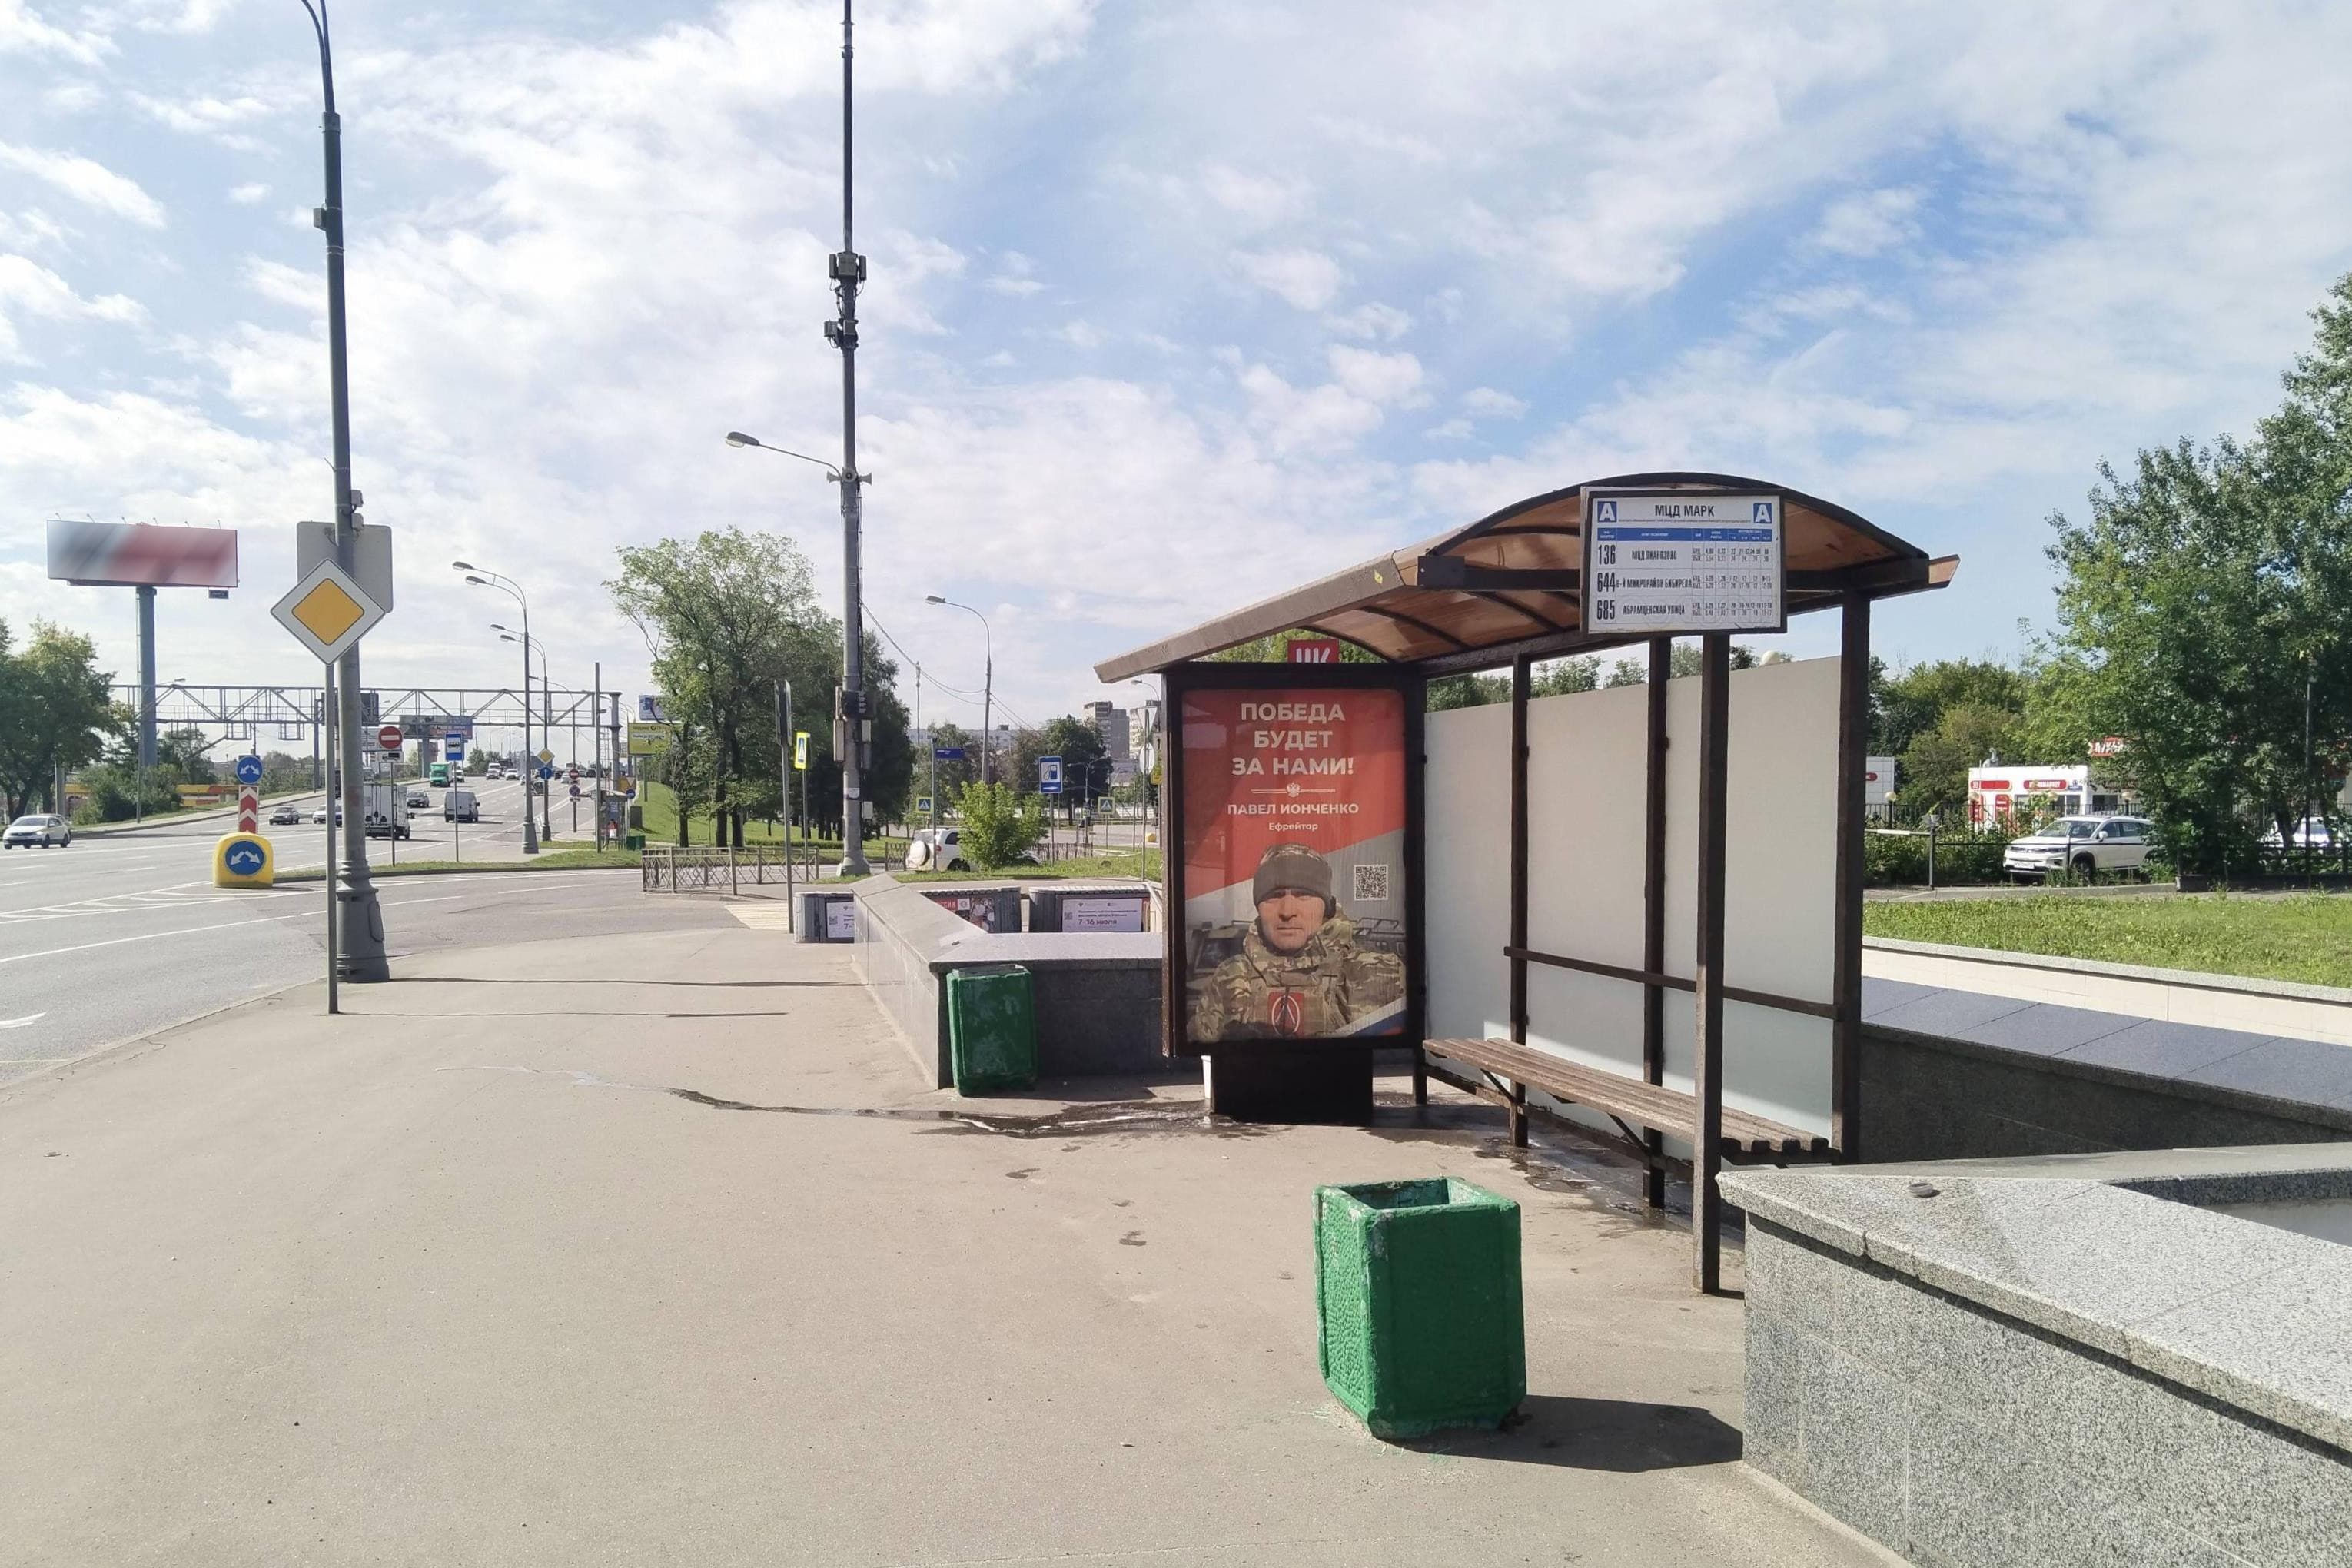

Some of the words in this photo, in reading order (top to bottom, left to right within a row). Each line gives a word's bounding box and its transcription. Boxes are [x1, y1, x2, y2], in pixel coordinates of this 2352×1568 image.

[1655, 504, 1680, 518] МЦД
[1683, 504, 1715, 517] МАРК
[1598, 545, 1616, 565] 136
[1632, 550, 1645, 560] МЦД
[1597, 572, 1616, 593] 644
[1596, 600, 1616, 620] 685
[1623, 605, 1666, 616] АБРАМЦЕВСКАЯ
[1667, 605, 1685, 616] УЛИЦА
[1241, 703, 1346, 724] ПОБЕДА
[1254, 730, 1333, 751] БУДЕТ
[1231, 757, 1264, 776] ЗА
[1272, 757, 1354, 776] НАМИ!
[1227, 803, 1276, 815] ПАВЕЛ
[1280, 803, 1360, 815] ИОНЧЕНКО
[1268, 822, 1319, 832] Ефрейтор
